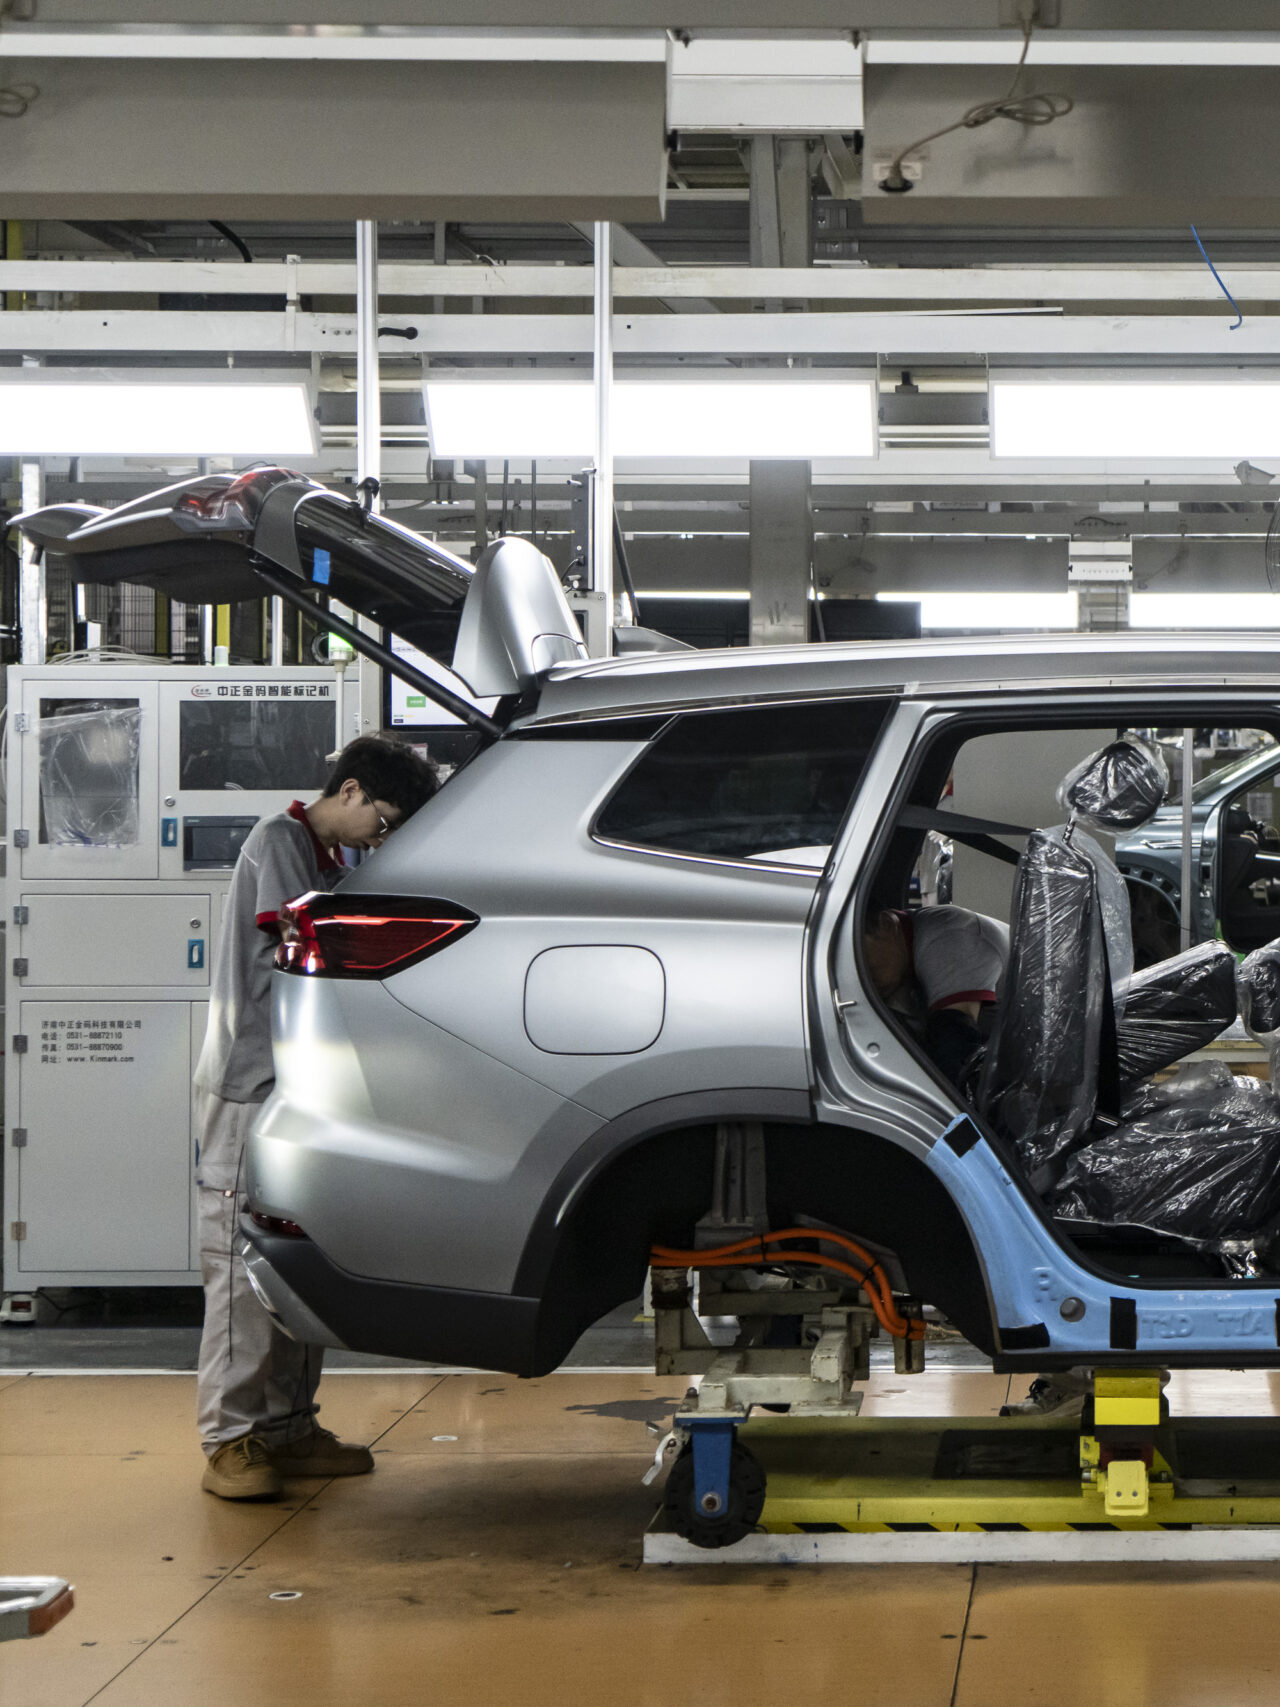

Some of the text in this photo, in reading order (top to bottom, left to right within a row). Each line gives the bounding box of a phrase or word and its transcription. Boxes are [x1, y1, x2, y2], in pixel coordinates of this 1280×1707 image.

[217, 685, 330, 697] 中正金码智能标记机
[41, 1020, 142, 1029] 济南中正金码科技有限公司
